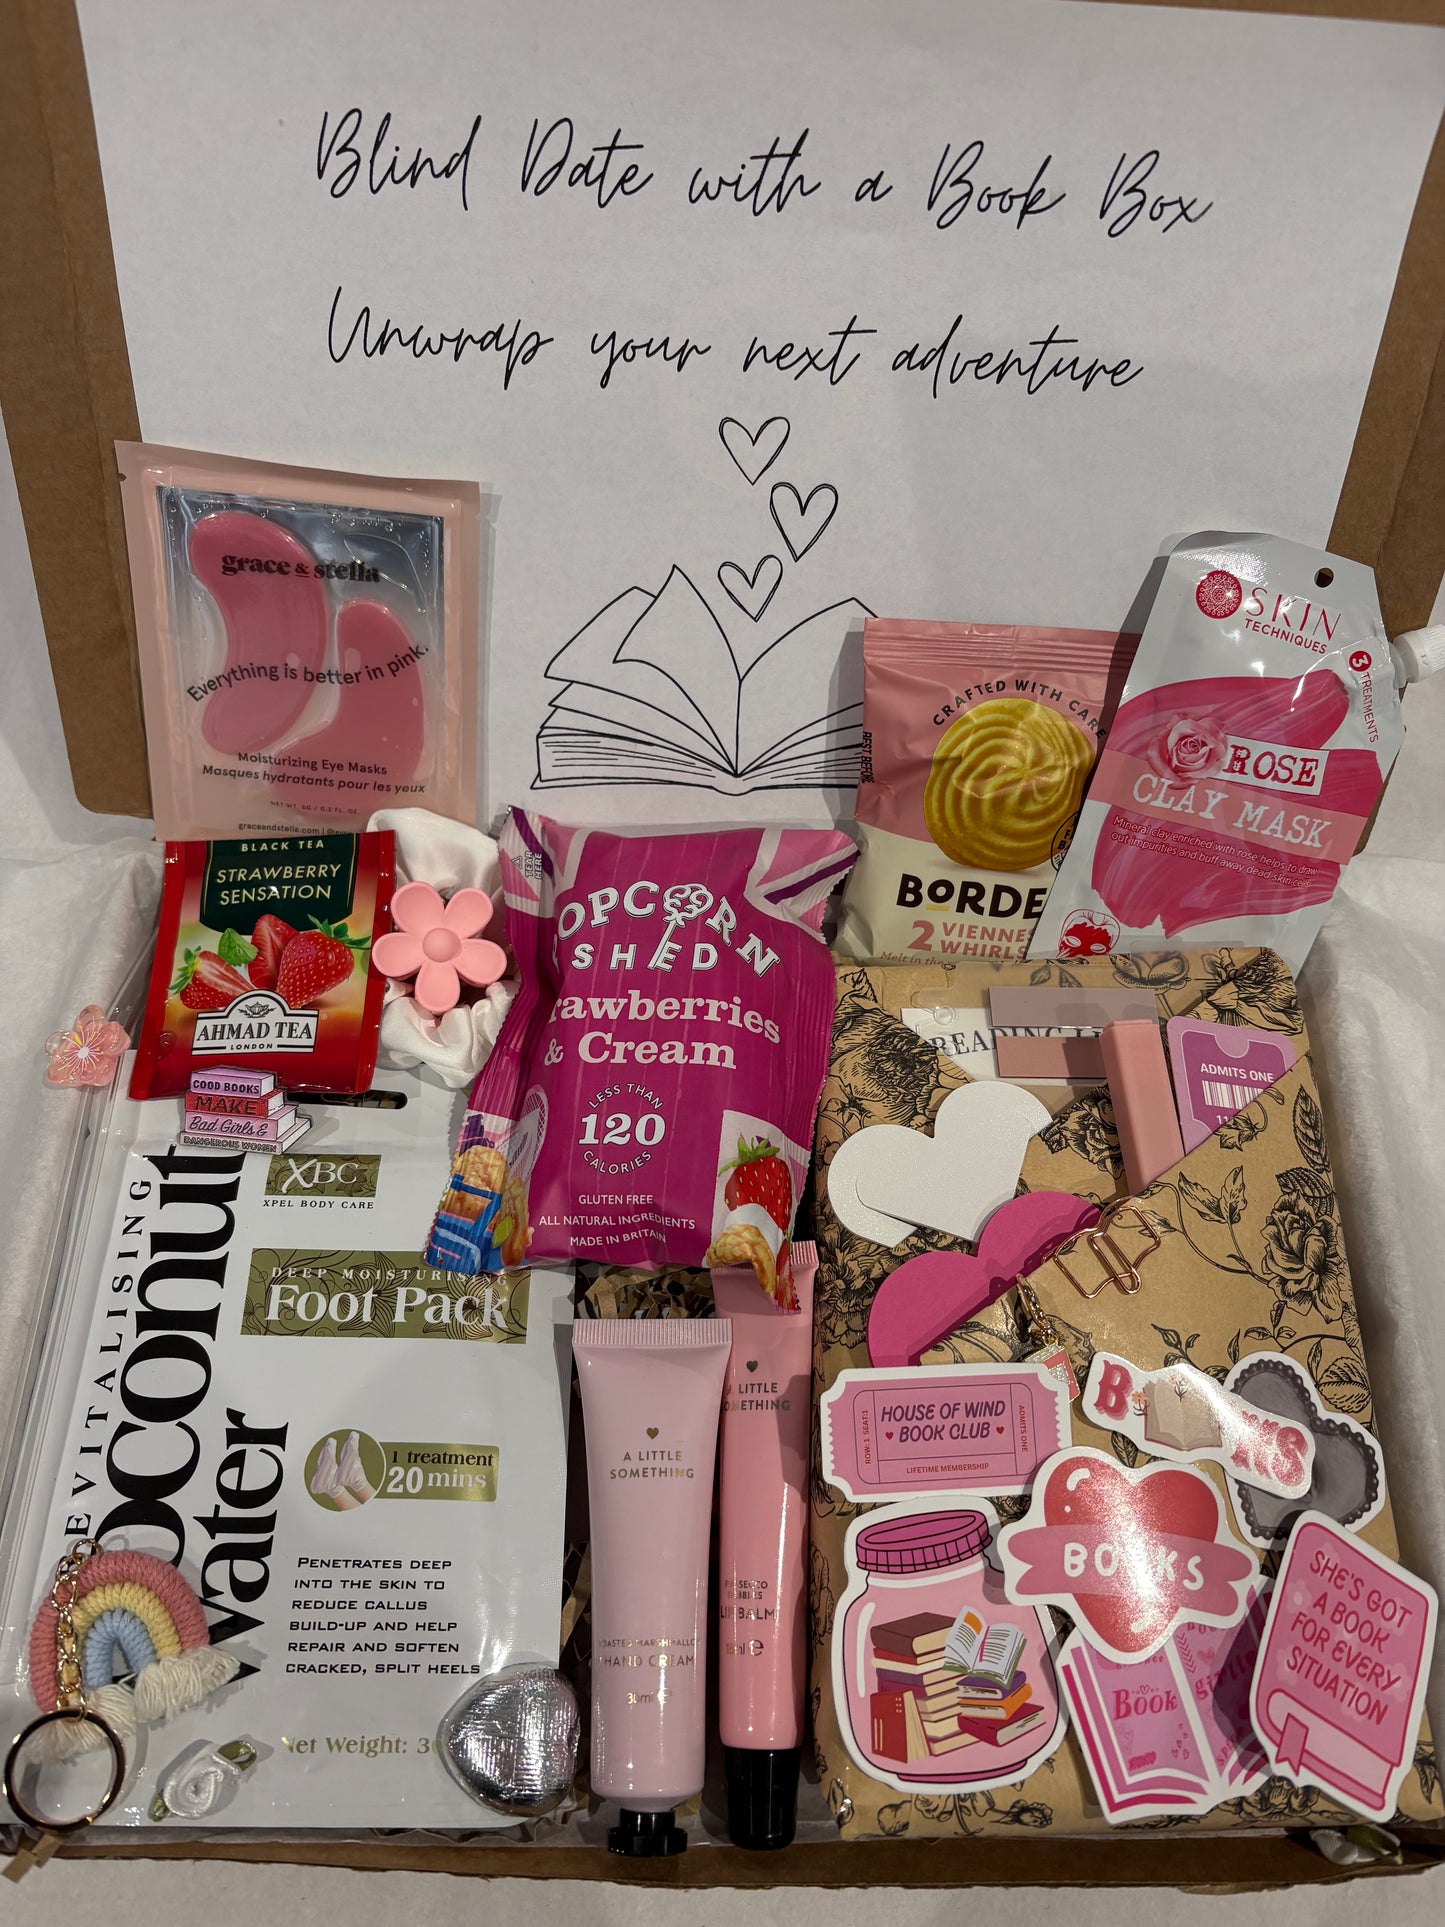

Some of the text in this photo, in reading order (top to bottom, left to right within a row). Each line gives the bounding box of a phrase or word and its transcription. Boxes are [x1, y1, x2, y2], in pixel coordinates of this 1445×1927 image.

[317, 108, 1213, 236] Blind Date with a Book Box
[329, 287, 1144, 397] Unwrap your next adventure
[222, 553, 381, 584] grace & stella
[1246, 587, 1342, 642] SKIN
[1244, 618, 1328, 655] TECHNIQUES
[187, 643, 429, 703] Everything is better in pink.
[933, 679, 1105, 740] CRAFTED WITH CARE
[1361, 672, 1379, 743] TREATMENTS
[238, 752, 388, 775] Moisturizing Eye Masks
[1222, 744, 1320, 788] ROSE
[202, 764, 425, 795] Masques hydratants pour les yeux
[1133, 774, 1333, 850] CLAY MASK
[239, 822, 320, 835] graceandstella.com
[241, 840, 325, 852] BLACK TEA
[1113, 816, 1318, 875] Mineral clay enriched with rose helps to draw
[1111, 832, 1291, 885] out impurities and buff away dead skin
[216, 863, 342, 884] STRAWBERRY
[220, 885, 331, 906] SENSATION
[552, 880, 780, 978] OPCORN
[907, 920, 934, 951] 2
[571, 943, 718, 972] SHED
[880, 951, 921, 964] Melt in
[197, 1022, 313, 1041] AHMAD TEA
[230, 1043, 273, 1051] LONDON
[544, 1031, 736, 1069] & Cream
[1201, 1063, 1274, 1083] ADMITS ONE
[224, 1082, 259, 1094] BOOKS
[588, 1084, 662, 1108] LESS THAN
[195, 1096, 257, 1115] MAKE
[190, 1116, 268, 1136] Bad Girls &
[578, 1113, 666, 1145] 120
[184, 1136, 277, 1153] DANGEROUS WOMEN
[583, 1150, 652, 1175] CALORIES
[282, 1158, 359, 1193] XBC
[263, 1199, 374, 1209] XPEL BODY CARE
[578, 1194, 653, 1205] GLUTEN FREE
[539, 1213, 695, 1229] ALL NATURAL INGREDIENTS
[570, 1229, 666, 1247] MADE IN BRITAIN
[272, 1267, 328, 1278] DEEP
[265, 1284, 508, 1328] Foot Pack
[60, 1180, 152, 1572] EVITALISING
[738, 1383, 777, 1394] LITTLE
[92, 1143, 247, 1686] oconut
[724, 1400, 791, 1411] OMETHING
[881, 1401, 1006, 1422] HOUSE OF WIND
[1019, 1405, 1027, 1436] ADMITS
[899, 1422, 990, 1443] BOOK CLUB
[408, 1449, 494, 1467] treatment
[623, 1450, 682, 1461] A LITTLE
[610, 1468, 695, 1480] SOMETHING
[907, 1463, 989, 1474] LIFETIME MEMBERSHIP
[387, 1467, 487, 1493] 20 mins
[297, 1557, 452, 1569] PENETRATES DEEP
[1064, 1542, 1204, 1590] BOKS
[294, 1579, 445, 1590] INTO THE SKIN TO
[1309, 1550, 1412, 1628] SHE'S GOT
[292, 1600, 427, 1610] REDUCE CALLUS
[738, 1607, 775, 1619] BALM
[289, 1621, 457, 1632] BUILD-UP AND HELP
[1313, 1591, 1390, 1654] A BOOK
[288, 1642, 459, 1653] REPAIR AND SOFTEN
[1291, 1611, 1401, 1691] FOR EVERY
[286, 1663, 480, 1675] CRACKED, SPLIT HEELS
[604, 1654, 695, 1667] HAND CREAM
[1287, 1645, 1389, 1726] SITUATION
[1112, 1689, 1177, 1720] Book
[326, 1736, 407, 1758] Weight:
